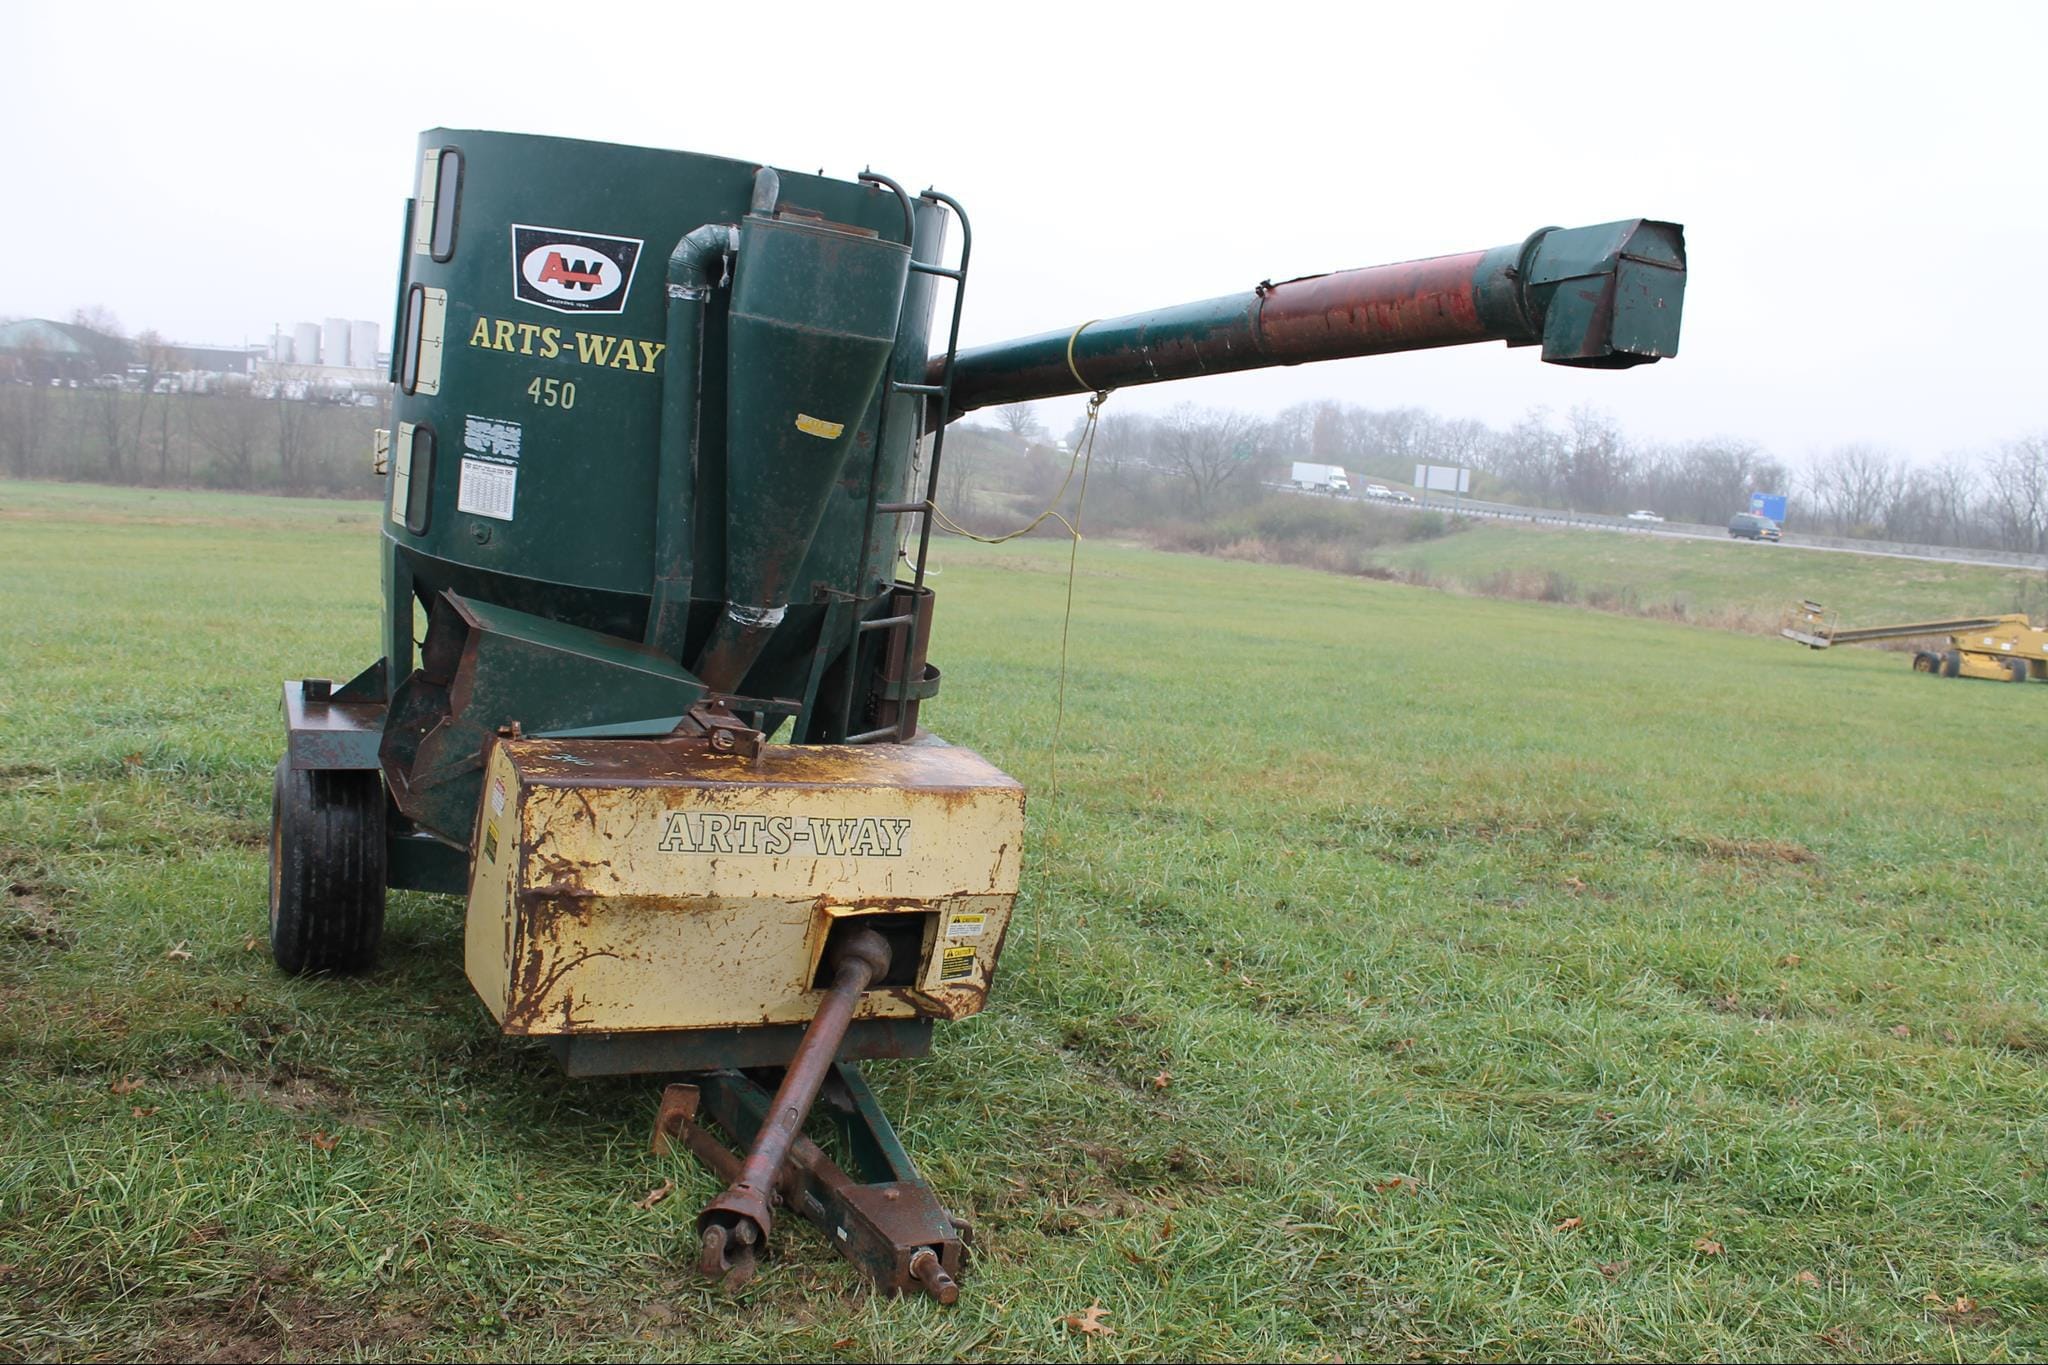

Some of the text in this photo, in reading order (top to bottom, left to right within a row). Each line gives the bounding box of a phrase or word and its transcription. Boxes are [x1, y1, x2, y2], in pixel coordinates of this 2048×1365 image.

[470, 316, 666, 373] ARTS-WAY
[527, 376, 576, 409] 450
[658, 812, 911, 857] ARTS-WAY
